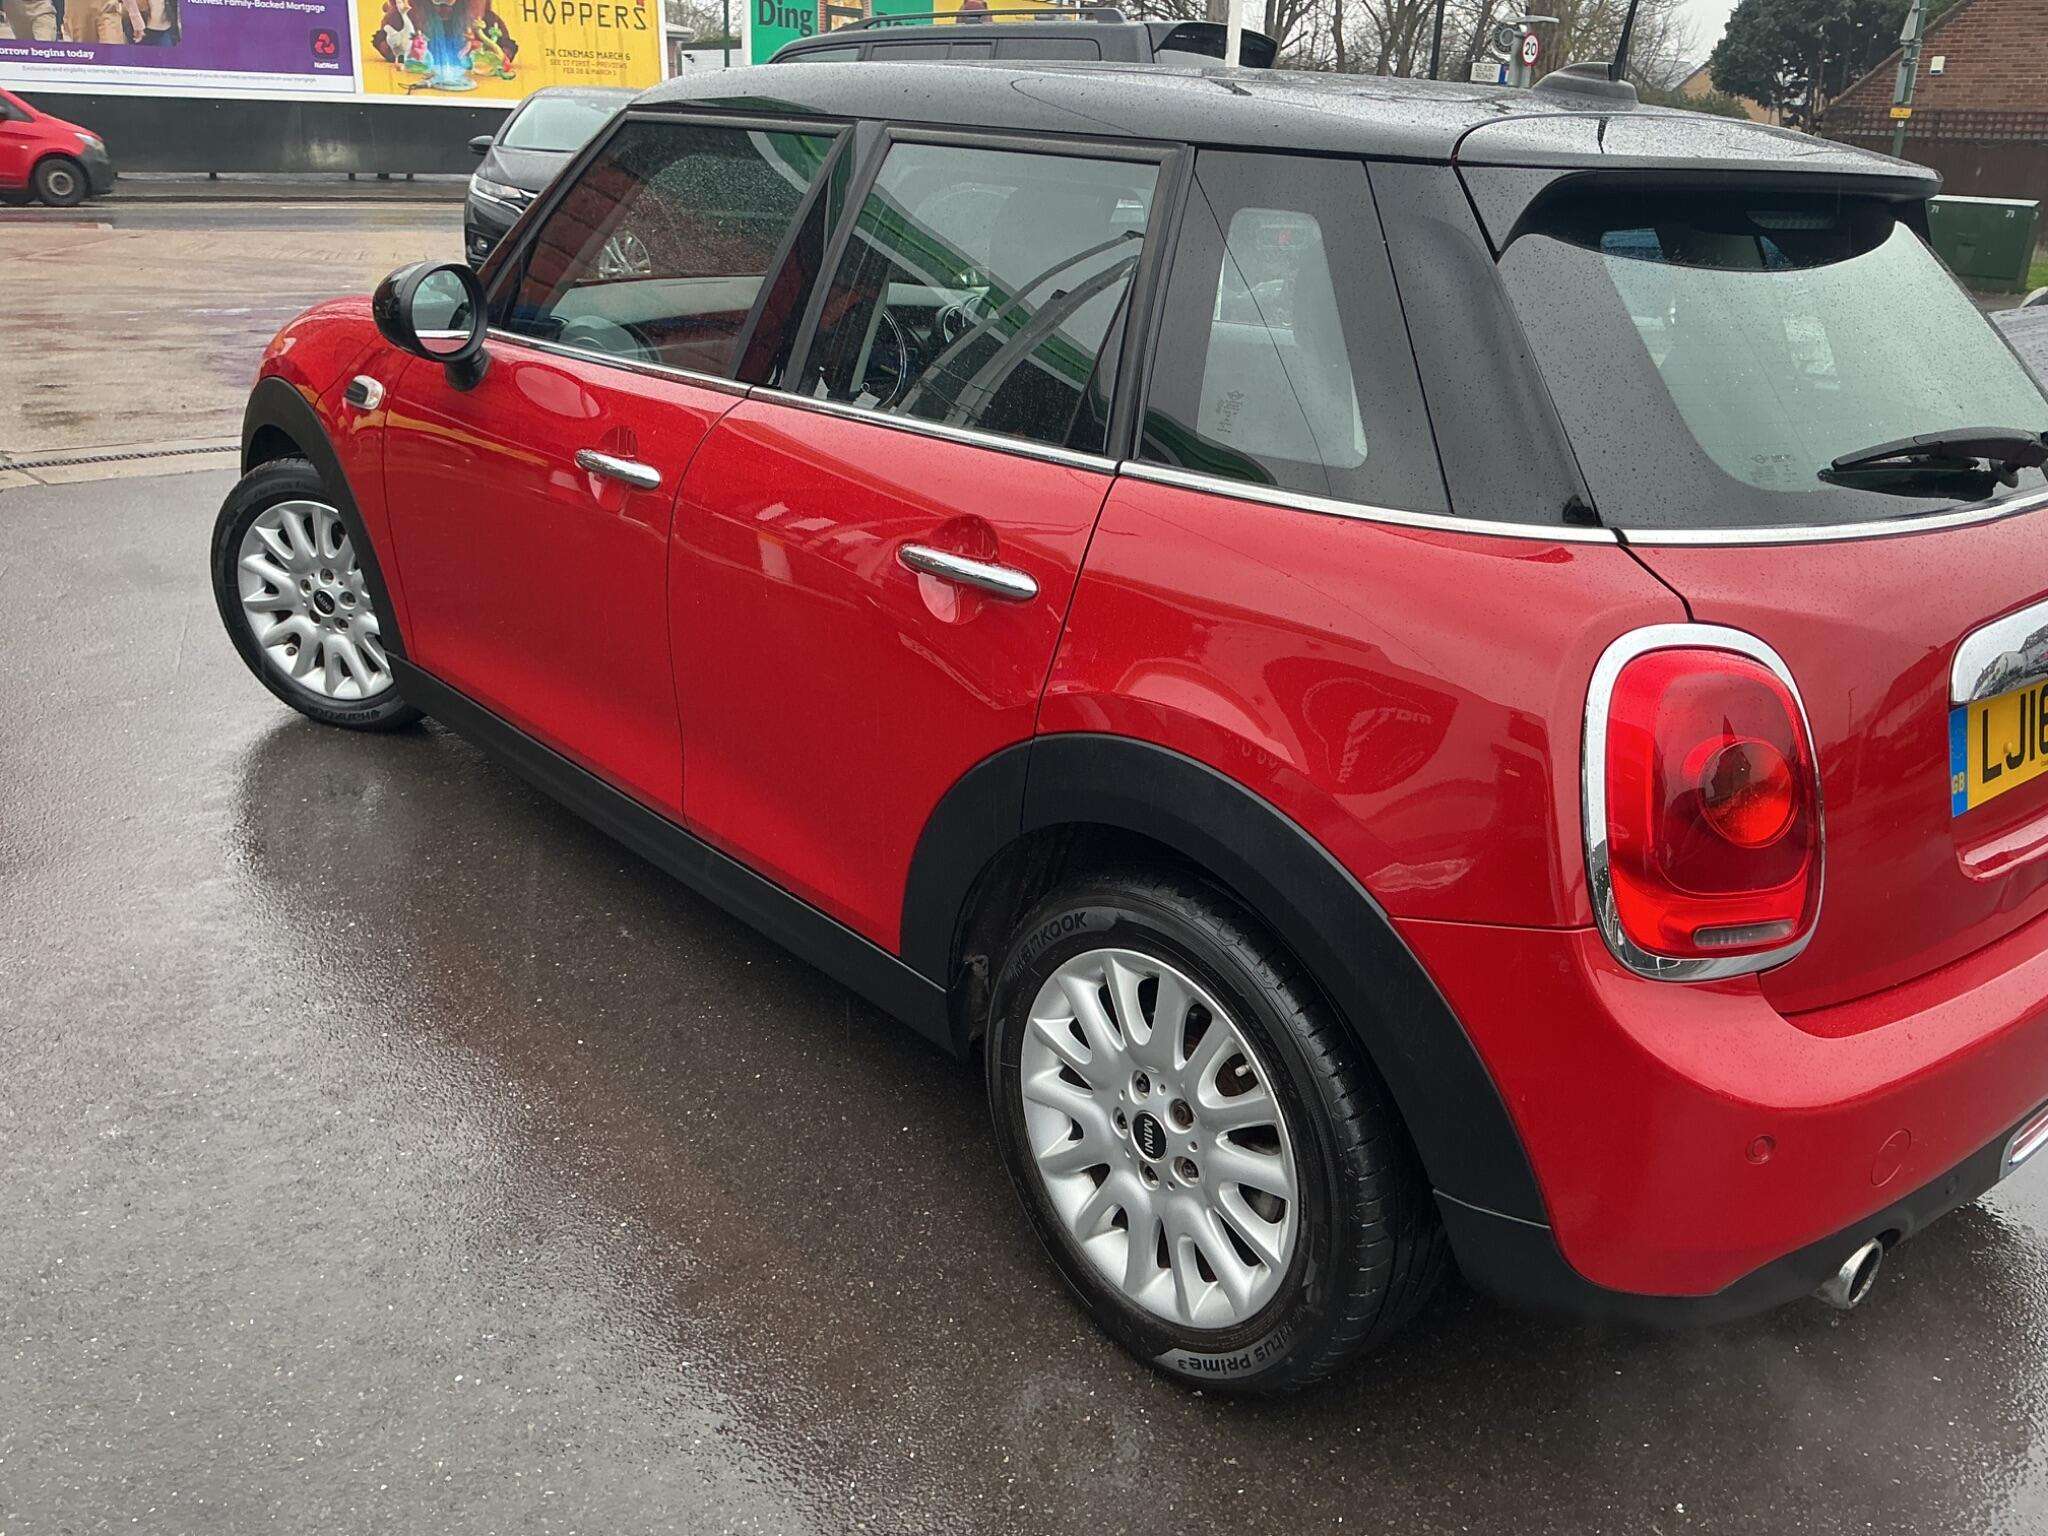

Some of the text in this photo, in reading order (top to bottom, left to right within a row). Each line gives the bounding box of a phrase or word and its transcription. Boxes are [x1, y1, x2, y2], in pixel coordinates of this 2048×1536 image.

[286, 2, 326, 13] Mortgage
[523, 0, 646, 30] HOPPERS
[758, 0, 813, 37] Ding
[31, 47, 65, 58] begins
[66, 49, 95, 60] today
[545, 48, 631, 61] IN CINEMAS MARCH 6
[1525, 42, 1537, 56] 20
[1951, 771, 1966, 795] GB
[1143, 1118, 1154, 1154] MINI
